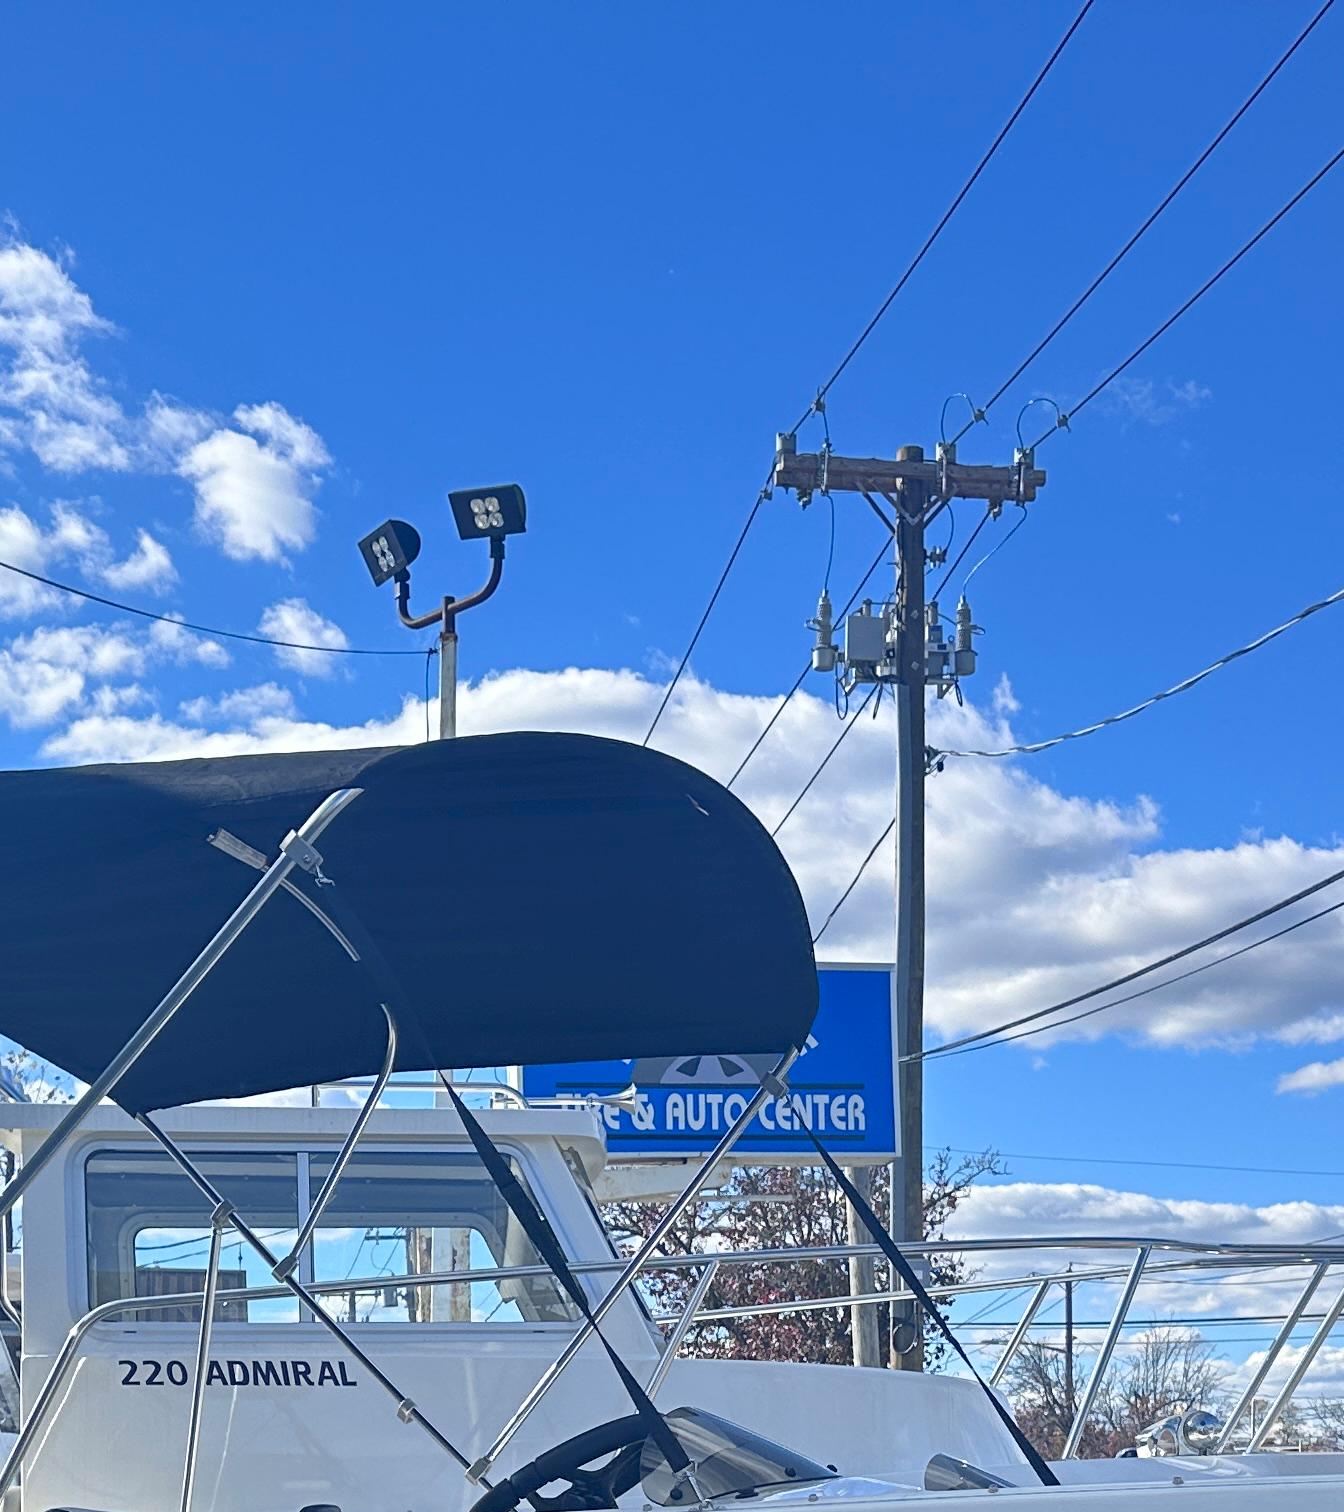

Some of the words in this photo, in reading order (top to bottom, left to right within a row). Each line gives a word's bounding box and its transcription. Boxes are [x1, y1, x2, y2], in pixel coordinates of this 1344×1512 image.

[666, 1093, 748, 1131] AUTO
[758, 1093, 865, 1131] CENTER
[118, 1360, 188, 1386] 220
[206, 1360, 358, 1386] ADMIRAL
